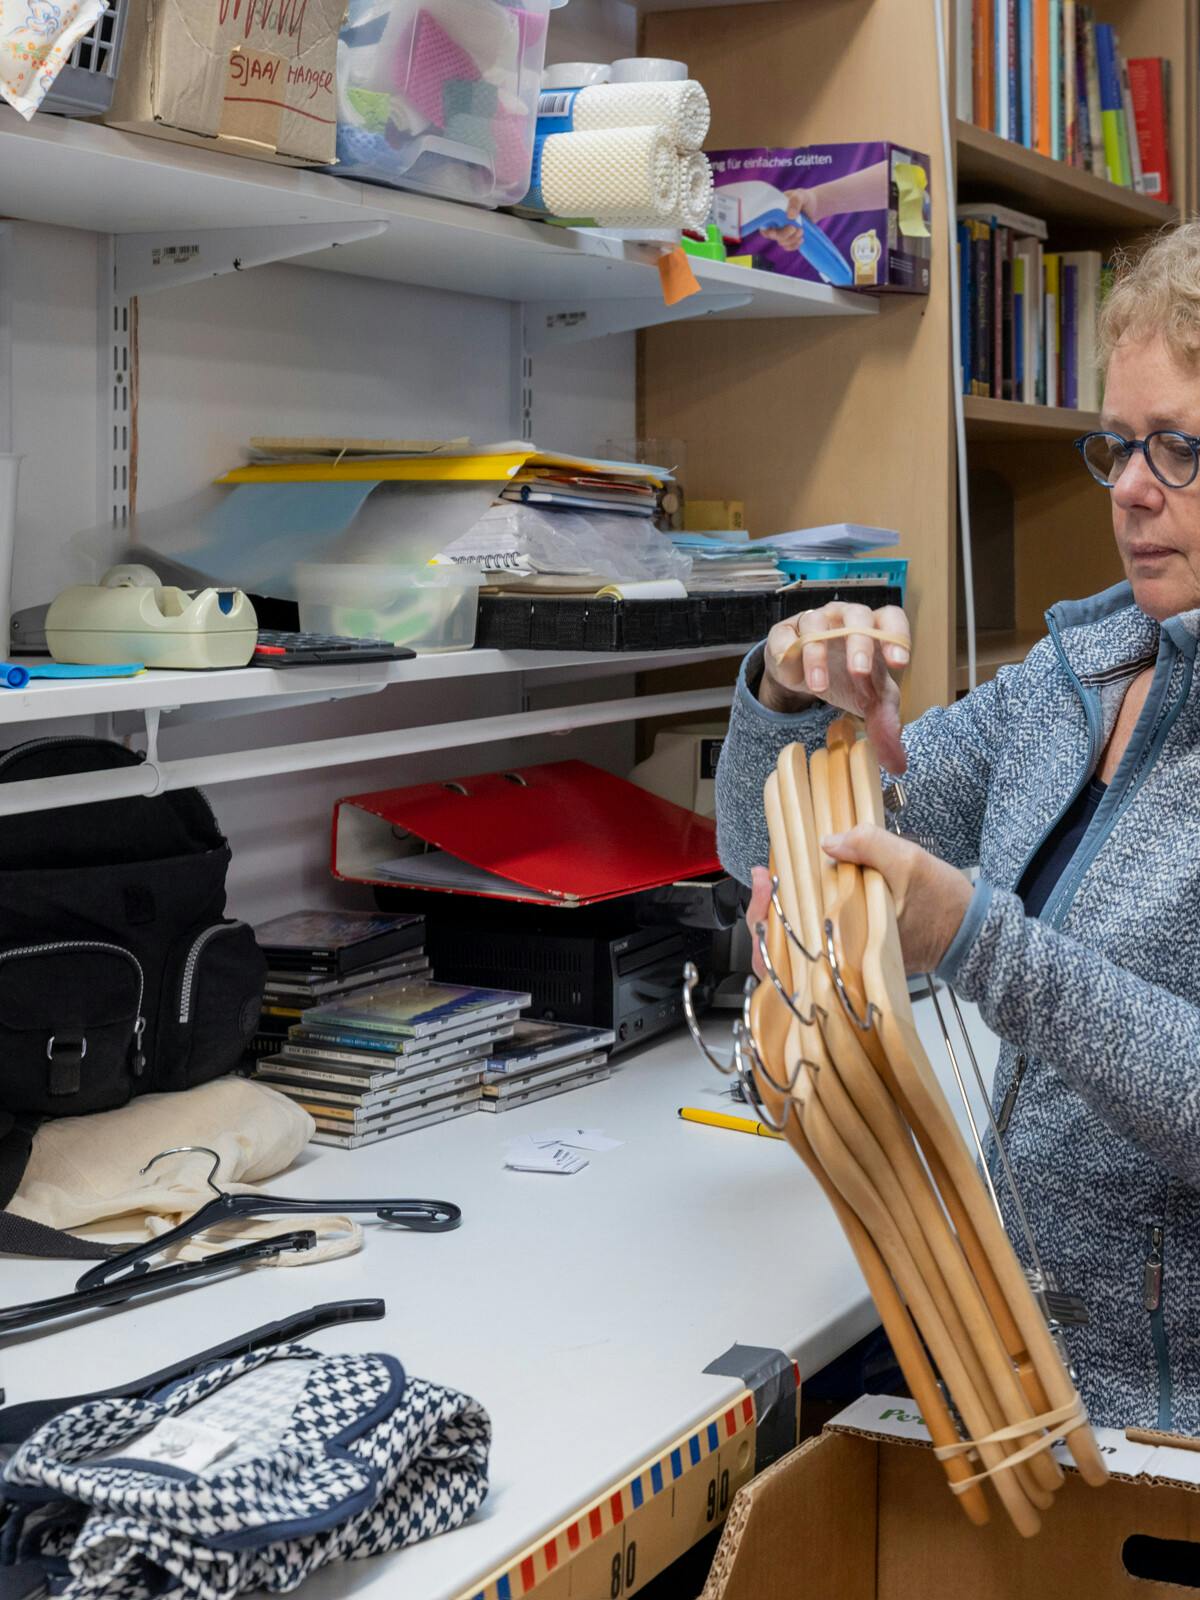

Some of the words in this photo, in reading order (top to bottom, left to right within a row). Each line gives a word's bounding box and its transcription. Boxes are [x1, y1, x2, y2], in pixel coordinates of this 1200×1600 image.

[743, 155, 792, 168] einfaches
[794, 153, 832, 167] Glätten
[706, 1468, 729, 1522] 90
[611, 1541, 636, 1600] 80
